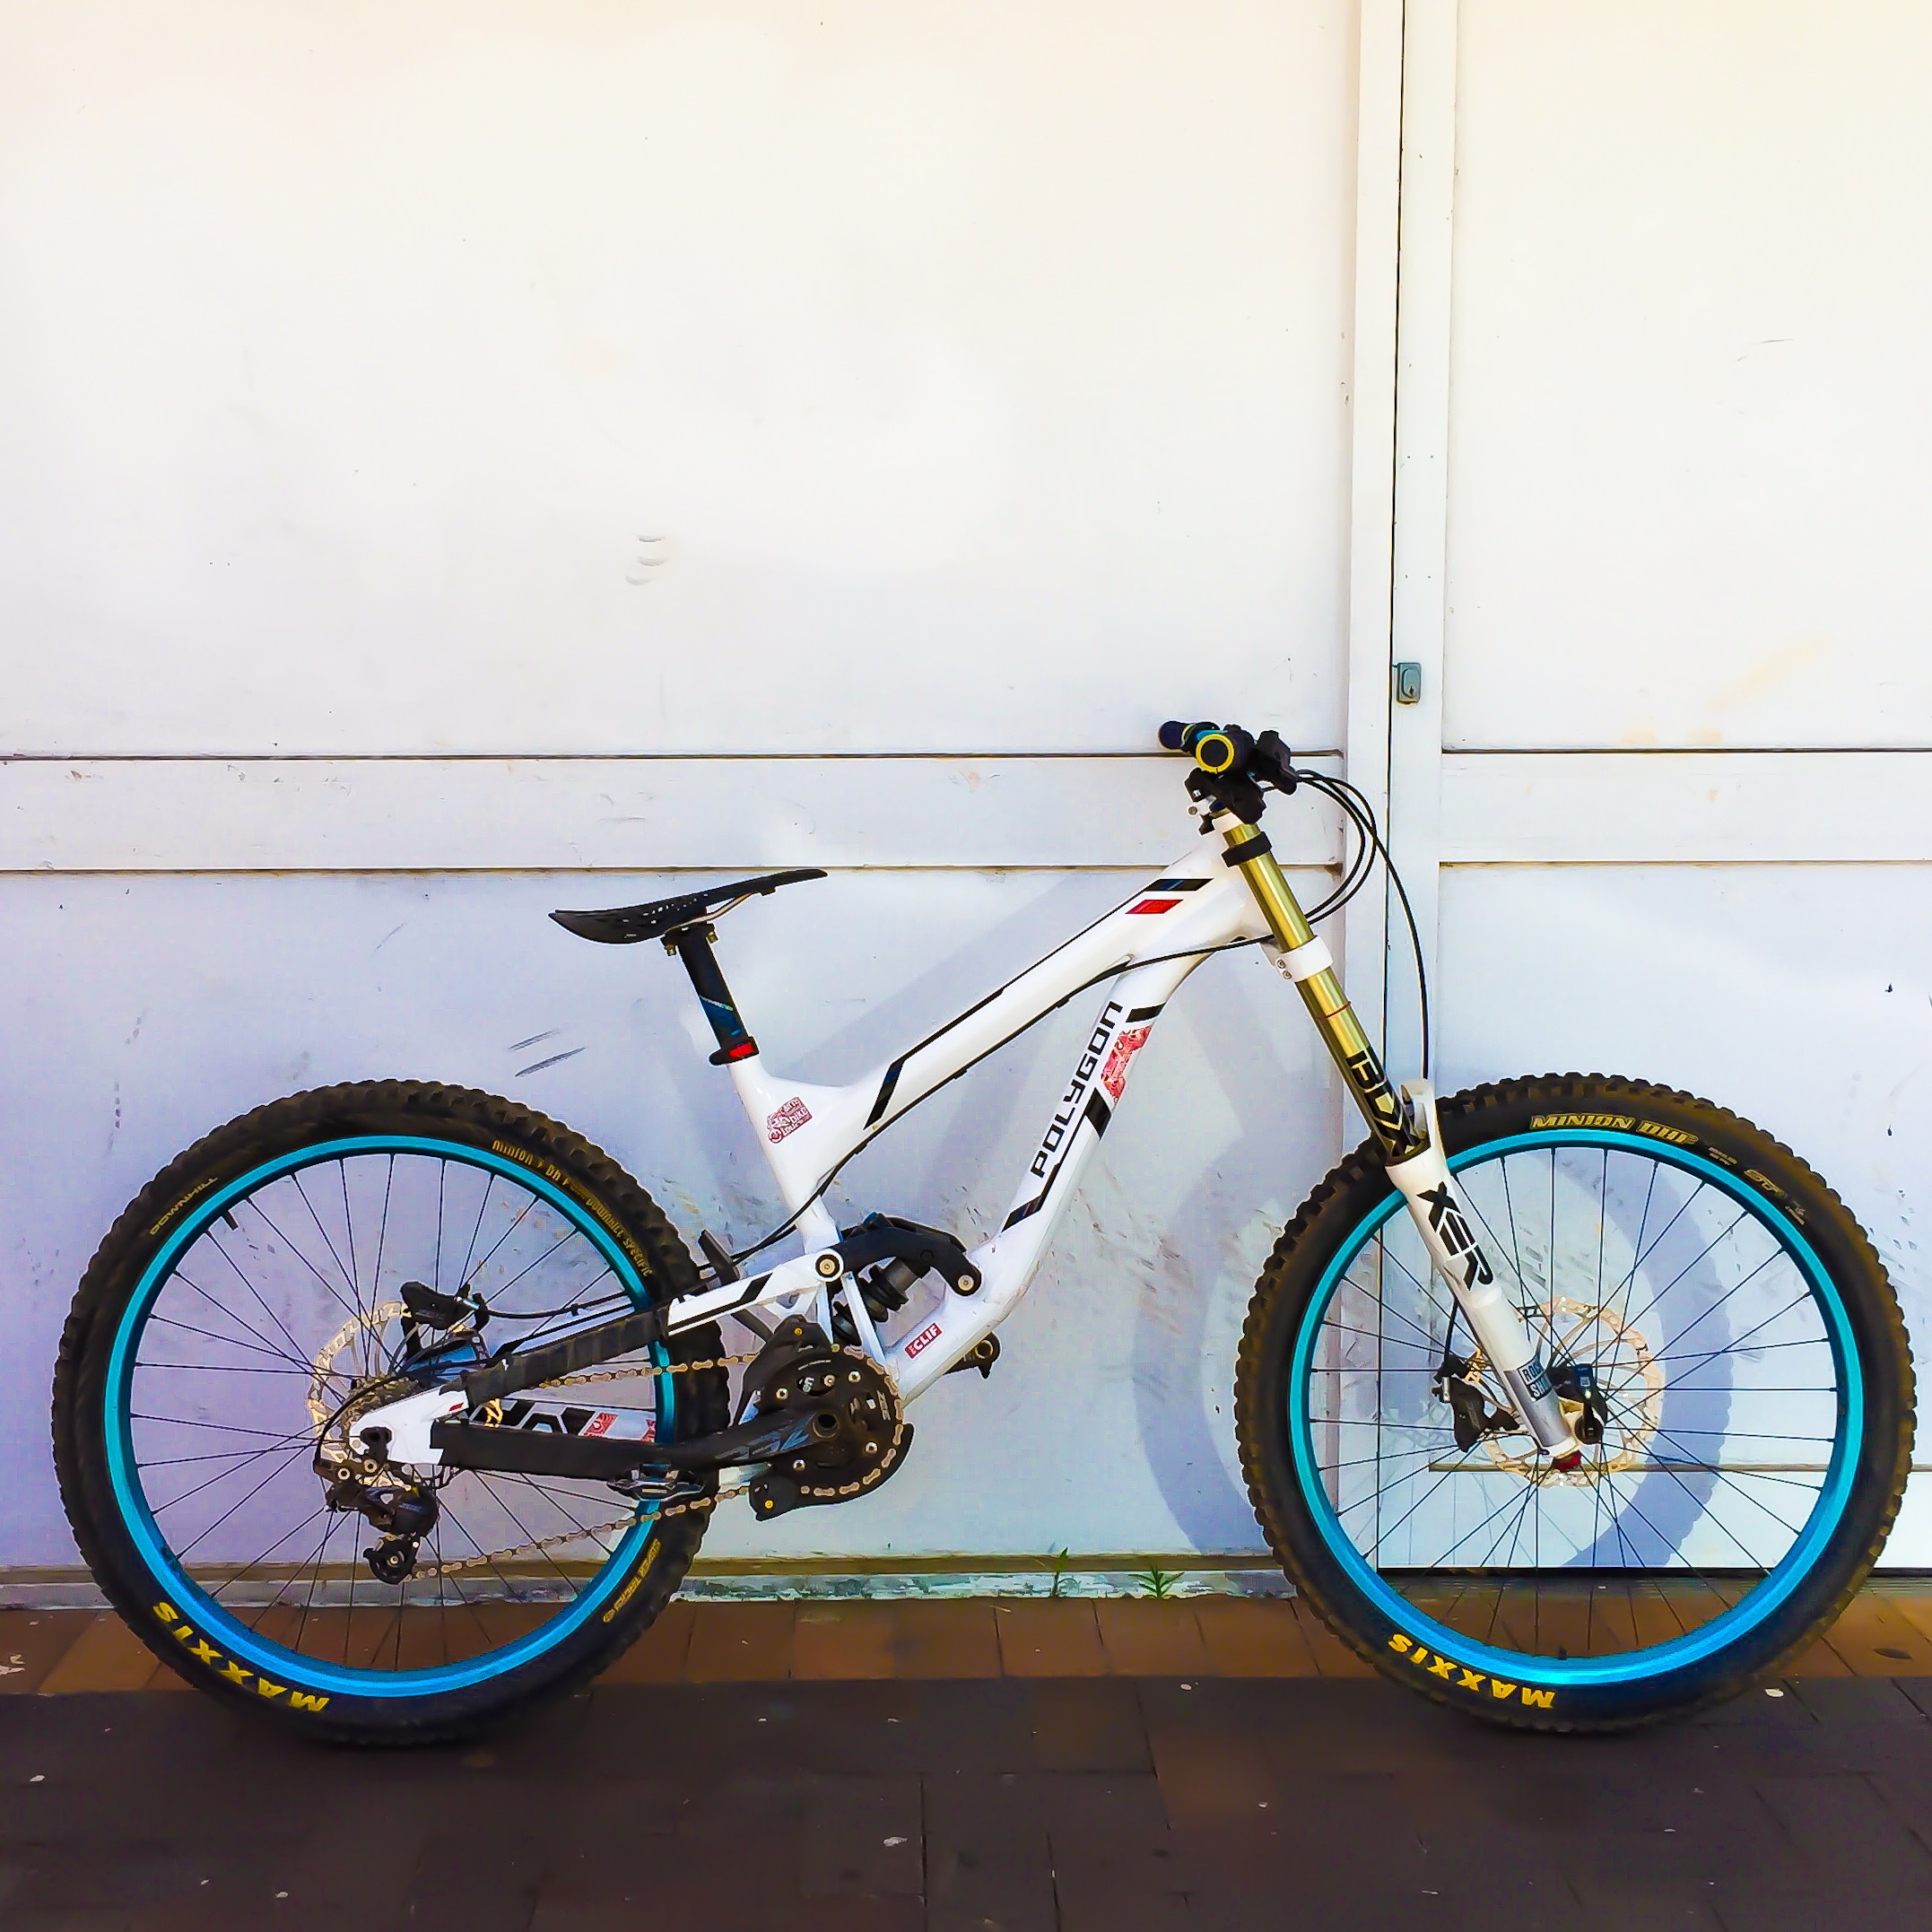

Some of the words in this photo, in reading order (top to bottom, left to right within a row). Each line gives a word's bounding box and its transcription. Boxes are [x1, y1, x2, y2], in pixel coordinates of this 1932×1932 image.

[1030, 1000, 1124, 1179] POLYGON
[1530, 1113, 1636, 1131] MINION
[149, 1176, 220, 1236] DOWNHILL
[152, 1601, 330, 1712] MAXXIS
[1388, 1633, 1556, 1709] MAXXIS
